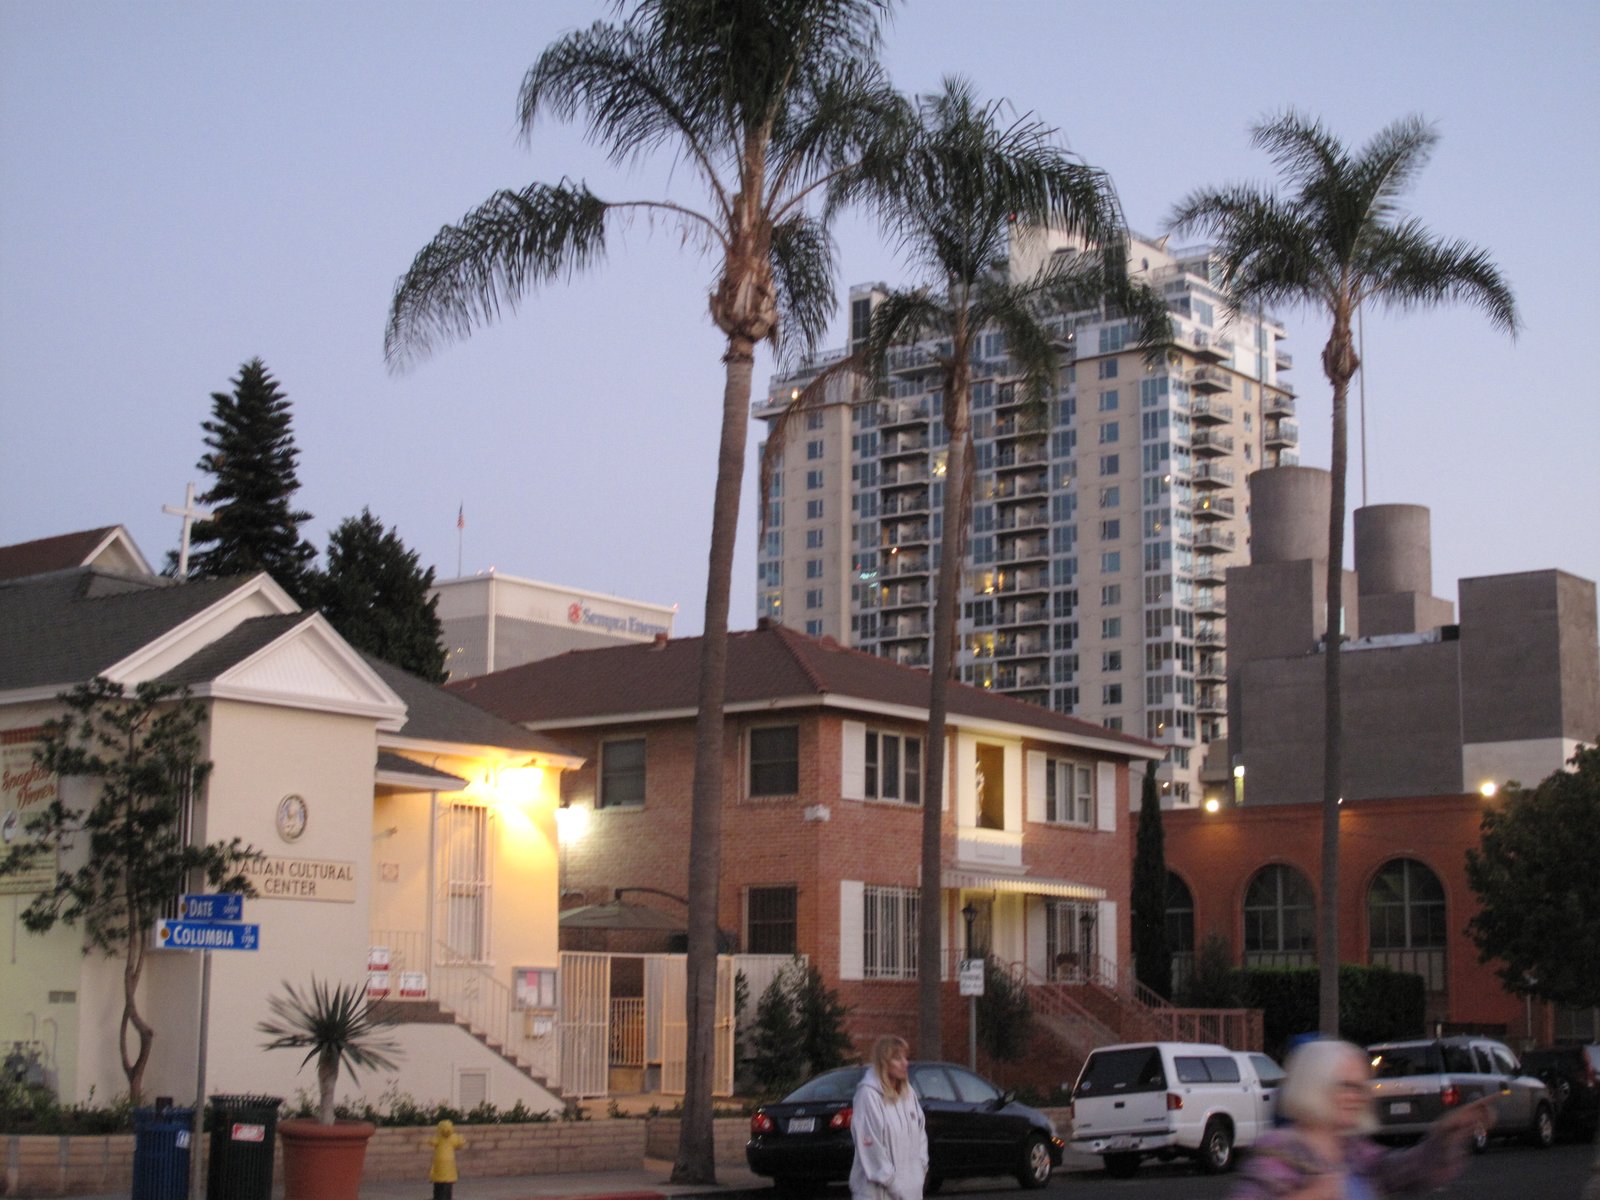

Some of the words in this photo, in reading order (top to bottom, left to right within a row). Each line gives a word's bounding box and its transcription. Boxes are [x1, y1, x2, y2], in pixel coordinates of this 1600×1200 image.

[228, 858, 284, 876] TALIAN
[288, 861, 353, 881] CULTURAL
[264, 879, 316, 896] CENTER
[189, 898, 213, 917] DATE
[173, 924, 234, 946] COLUMBIA
